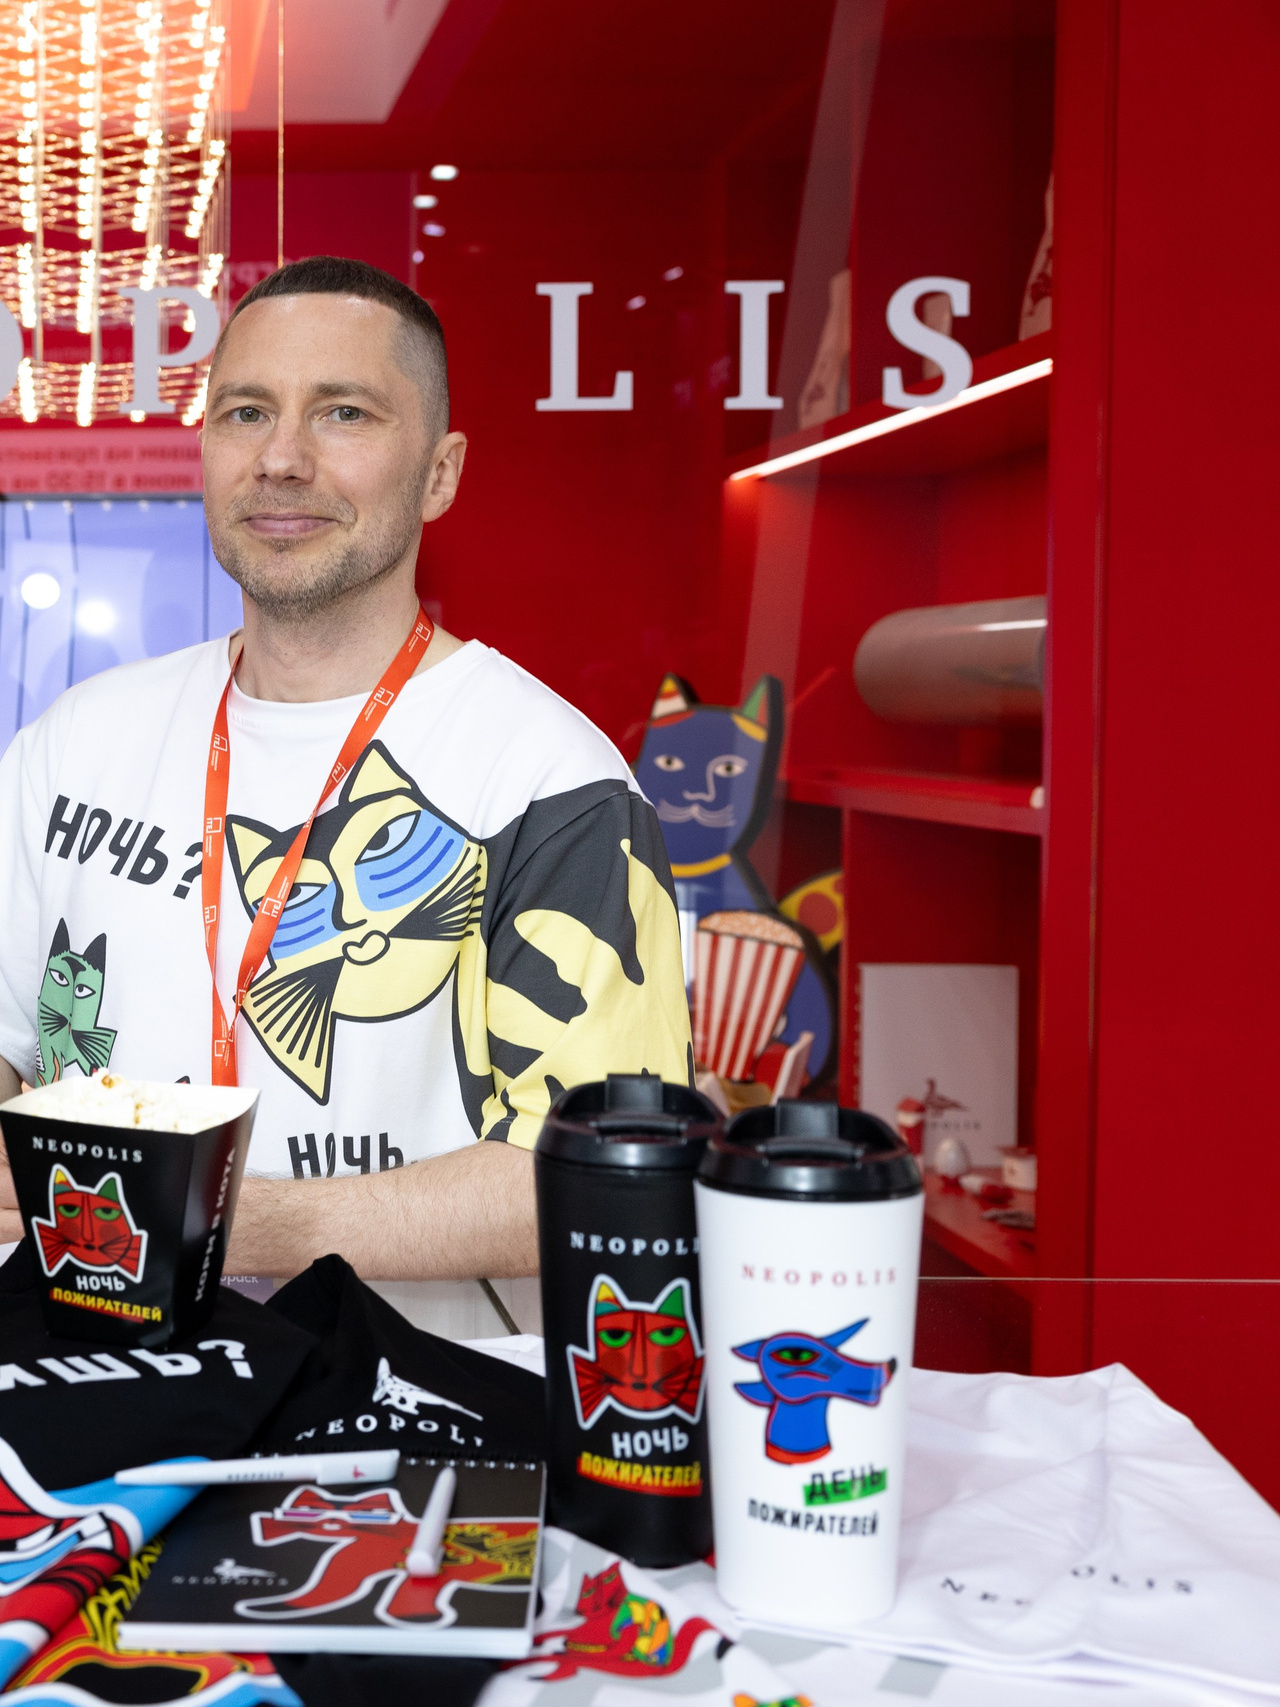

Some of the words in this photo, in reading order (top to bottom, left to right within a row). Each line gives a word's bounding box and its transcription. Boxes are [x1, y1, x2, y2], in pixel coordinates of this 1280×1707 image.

[44, 793, 204, 900] НОЧЬ?
[31, 1136, 144, 1163] NEOPOLIS
[75, 1275, 126, 1292] НОЧЬ
[741, 1264, 896, 1288] NEOPOLIS
[52, 1287, 163, 1322] ПОЖИРАТЕЛЕЙ
[611, 1425, 690, 1459] НОЧЬ
[580, 1451, 702, 1489] ПОЖИРАТЕЛЕЙ
[808, 1463, 883, 1502] ДЕНЬ
[747, 1498, 879, 1536] ПОЖИРАТЕЛЕЙ
